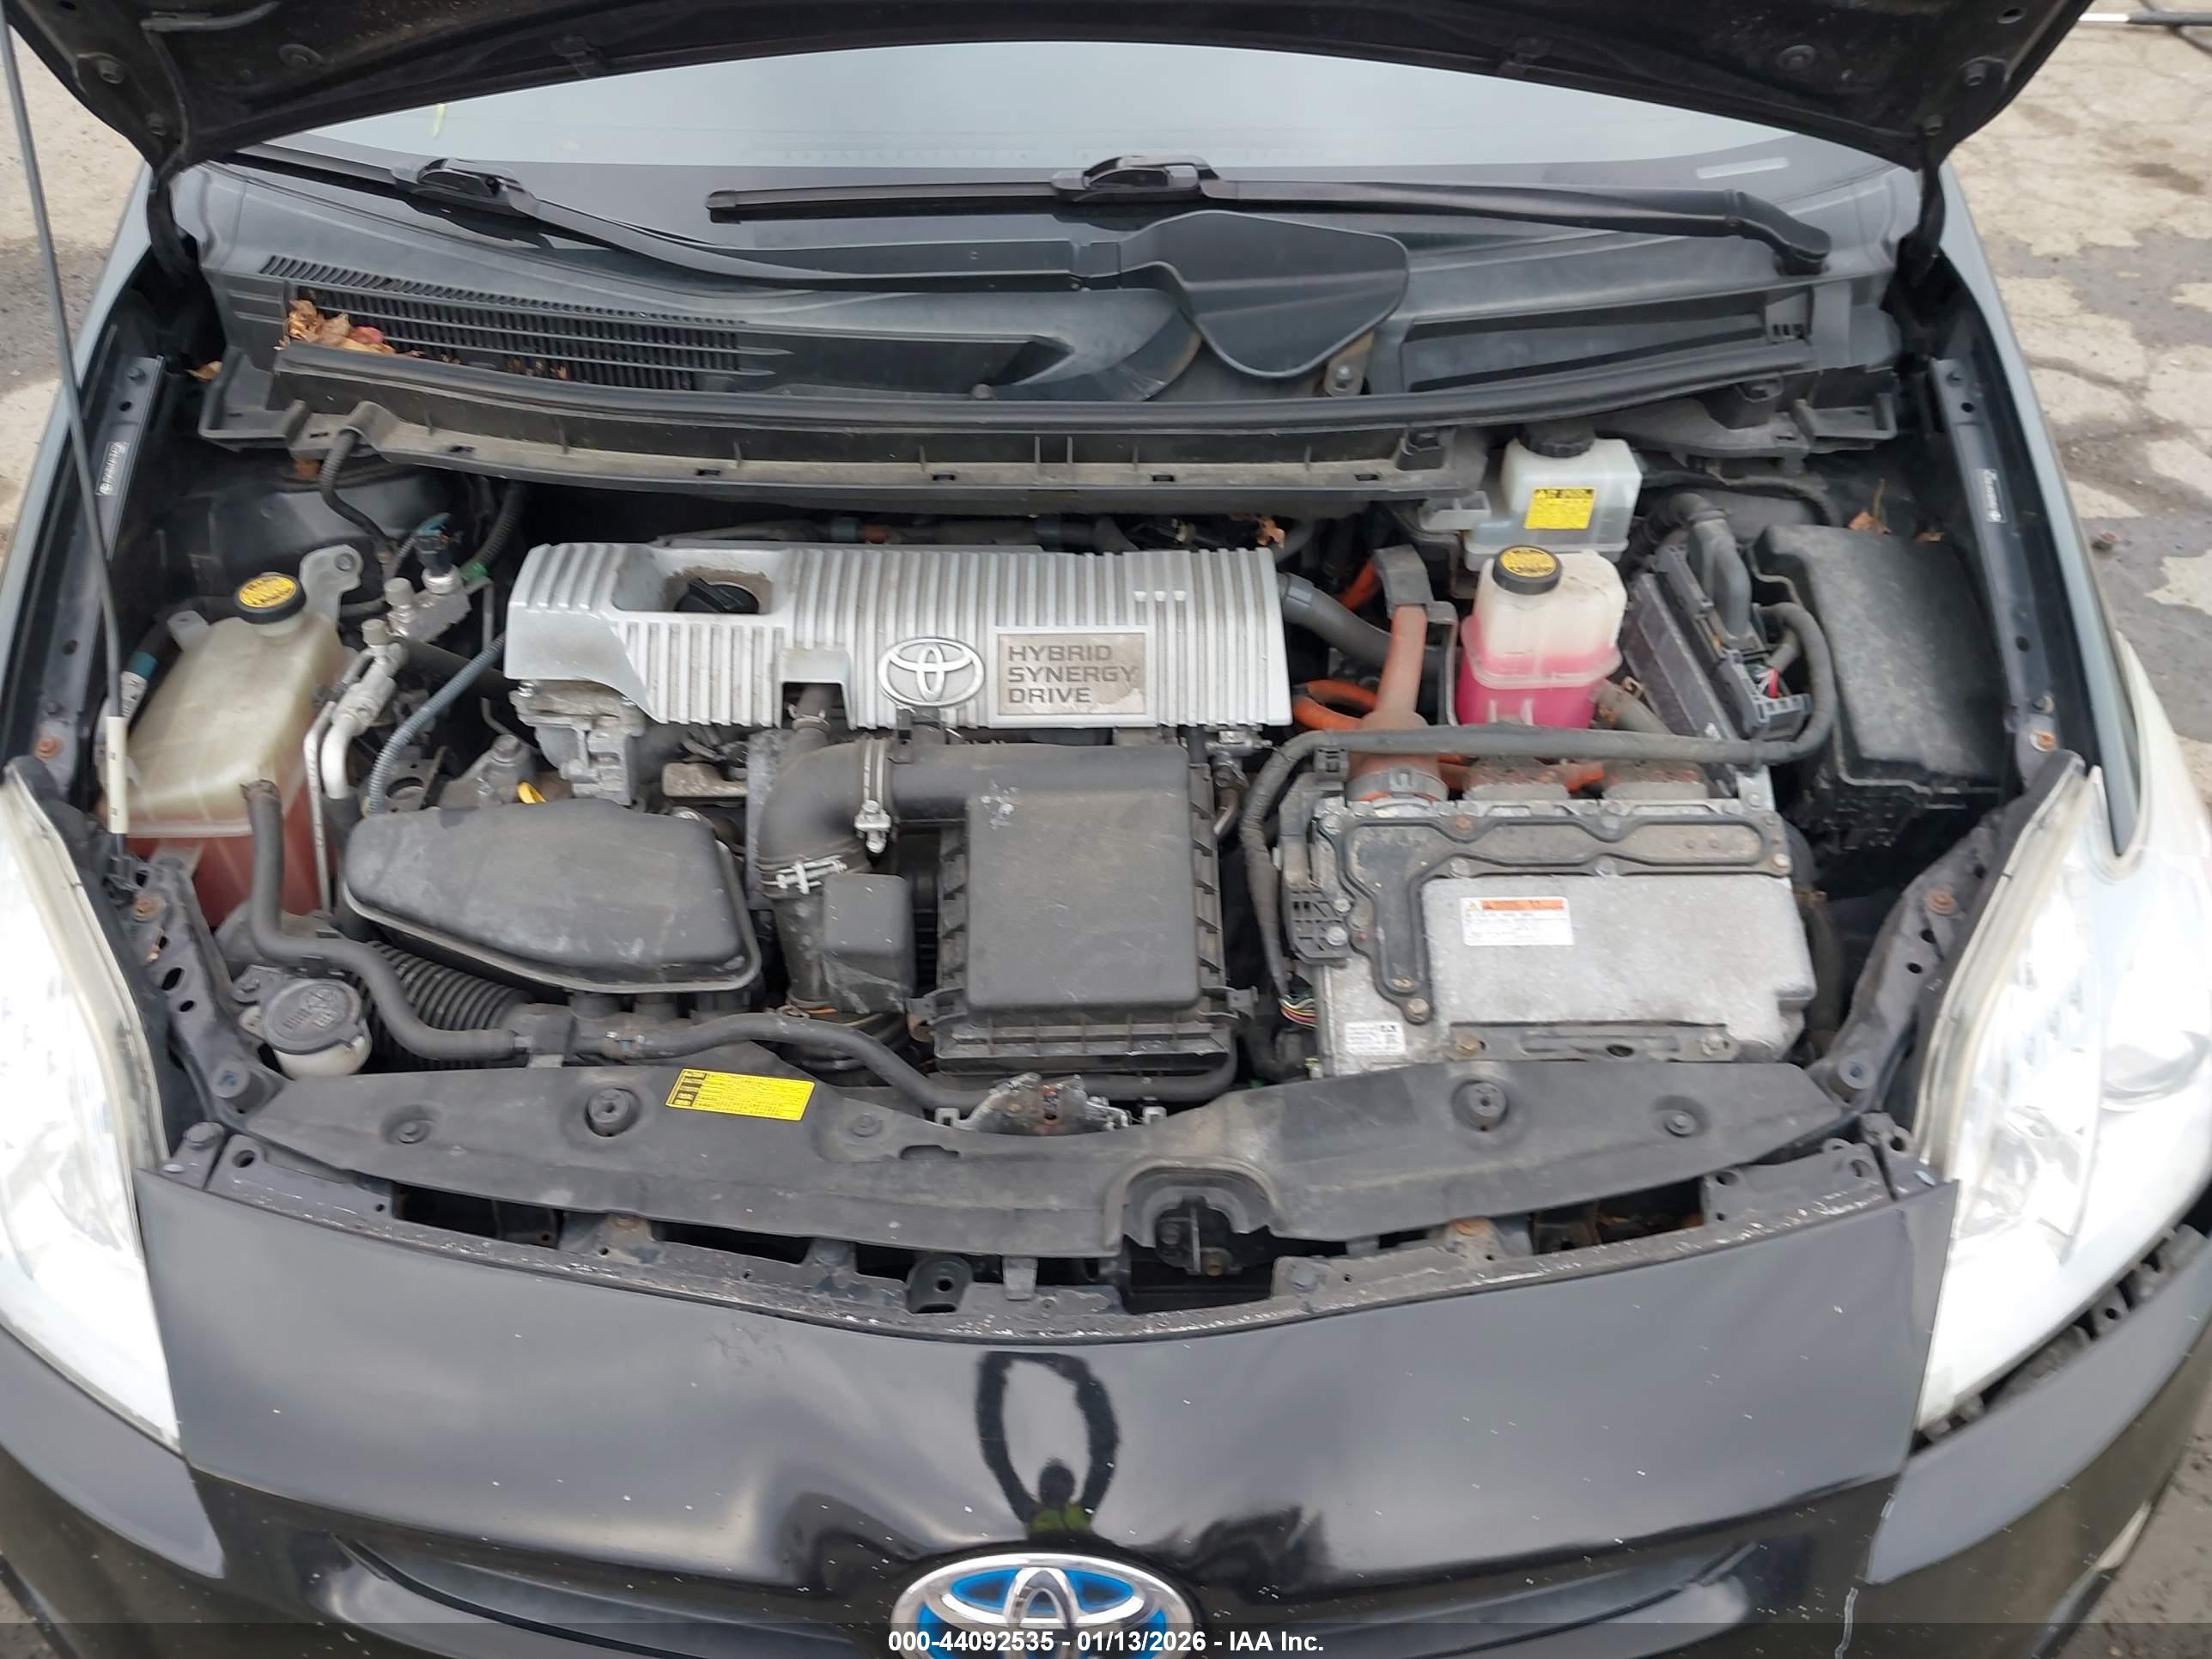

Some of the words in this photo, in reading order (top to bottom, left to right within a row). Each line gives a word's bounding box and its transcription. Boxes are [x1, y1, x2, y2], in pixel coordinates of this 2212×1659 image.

[1008, 645, 1114, 662] HYBRID
[1007, 665, 1140, 683] SYNERGY
[1008, 687, 1092, 704] DRIVE
